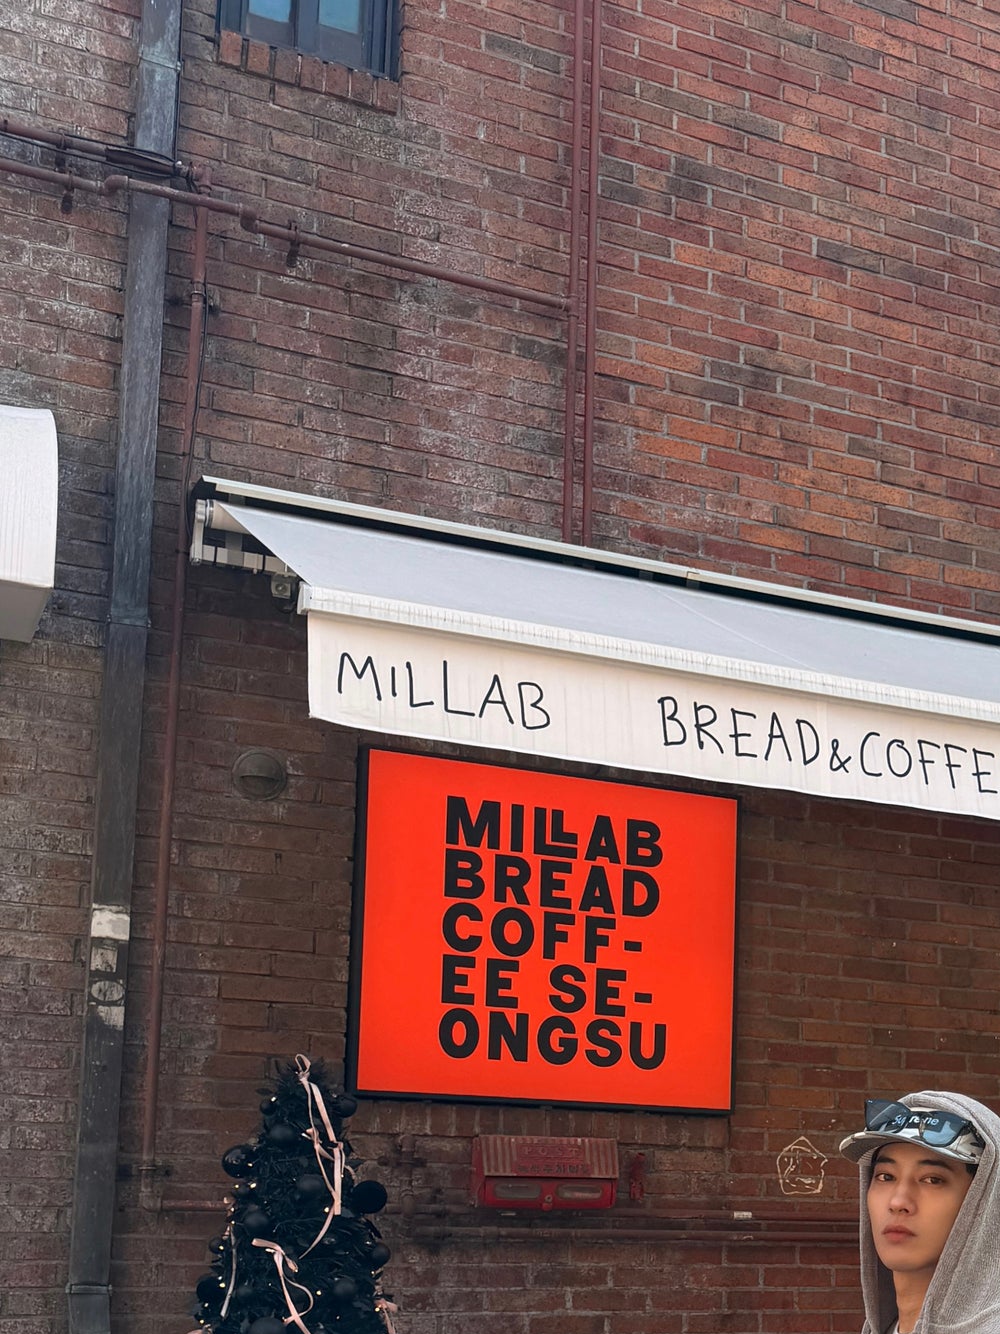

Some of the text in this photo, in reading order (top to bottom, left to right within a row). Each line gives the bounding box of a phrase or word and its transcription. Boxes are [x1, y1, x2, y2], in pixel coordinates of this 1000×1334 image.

[337, 652, 551, 730] MILLAB
[446, 795, 663, 868] MILLAB
[444, 848, 660, 917] BREAD
[442, 902, 643, 964] COFF-
[441, 953, 653, 1018] EE SE-
[438, 1007, 667, 1071] ONGSU
